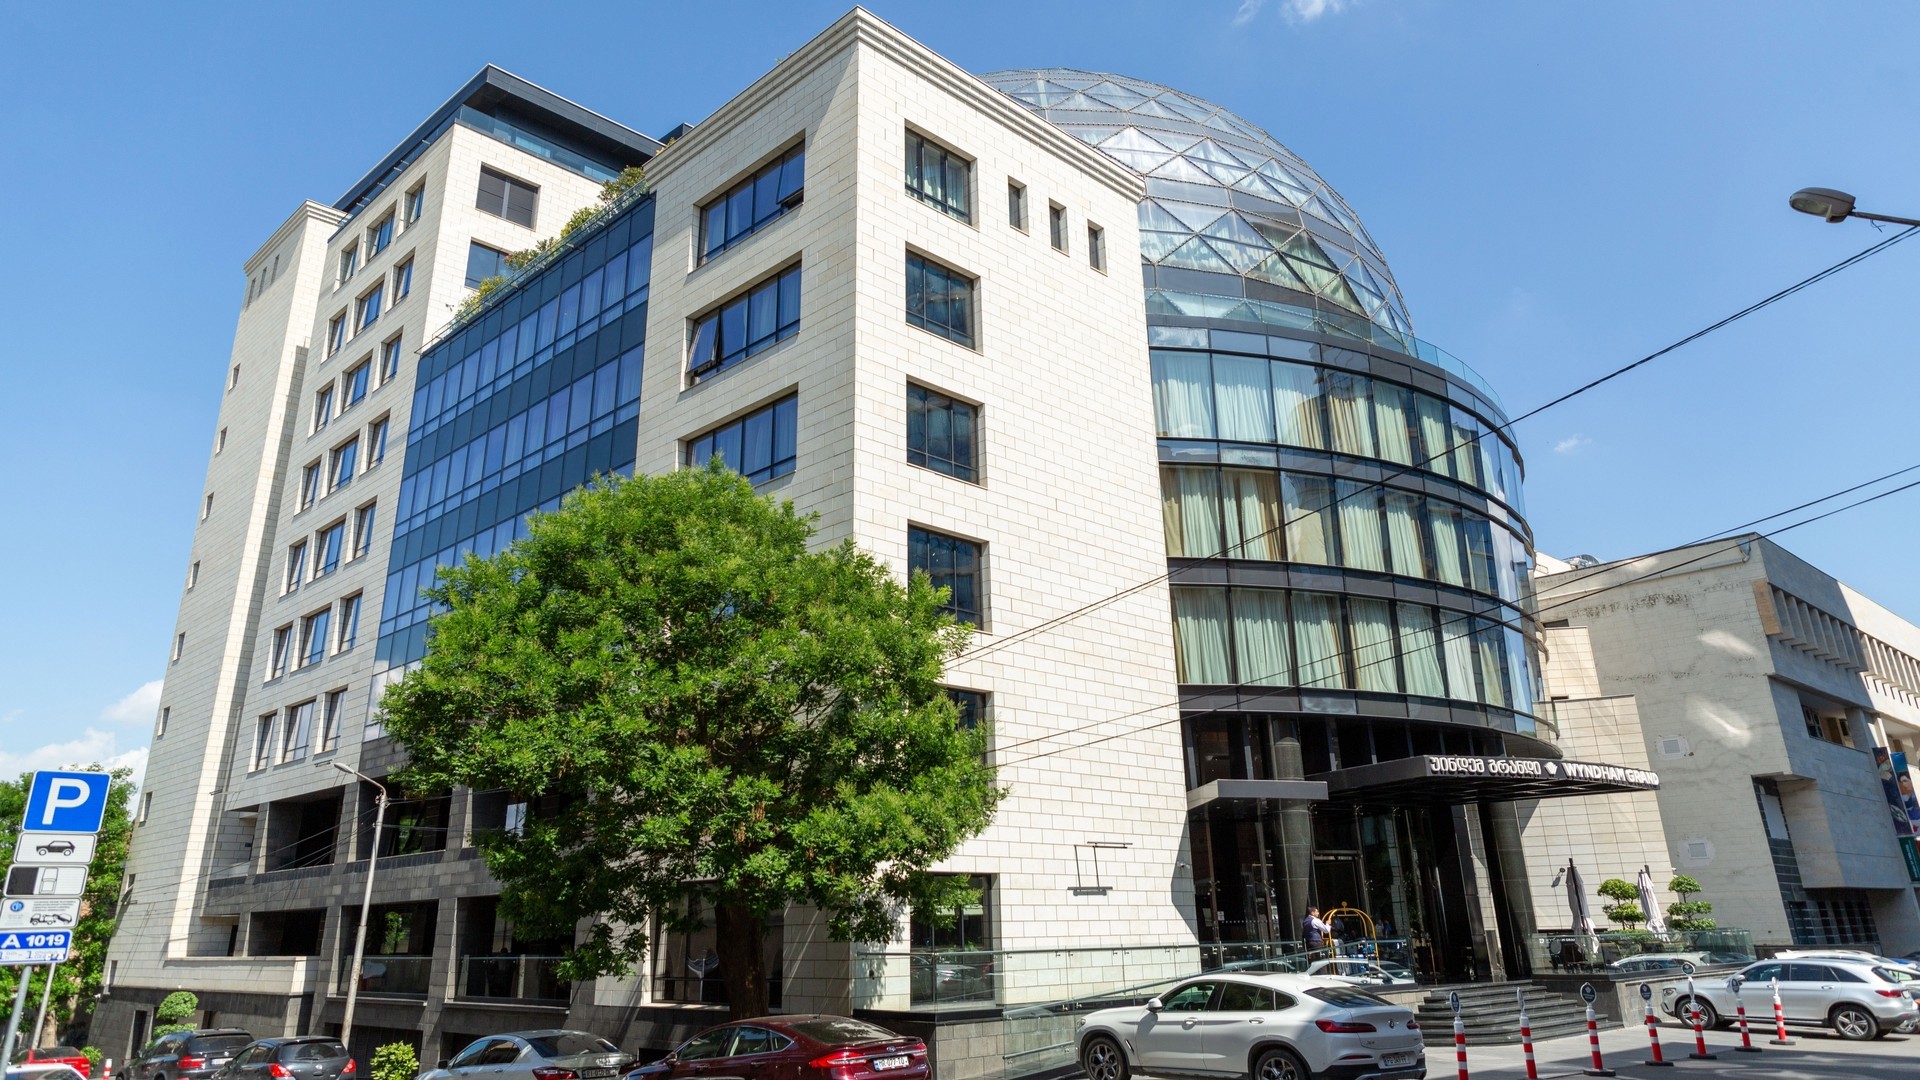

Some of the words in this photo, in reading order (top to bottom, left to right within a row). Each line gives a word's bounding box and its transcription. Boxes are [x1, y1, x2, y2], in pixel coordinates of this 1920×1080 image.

[1561, 763, 1626, 781] WYNDHAM
[1625, 769, 1660, 786] GRAND
[42, 777, 90, 825] P
[1, 934, 21, 949] A
[26, 934, 66, 947] 1019
